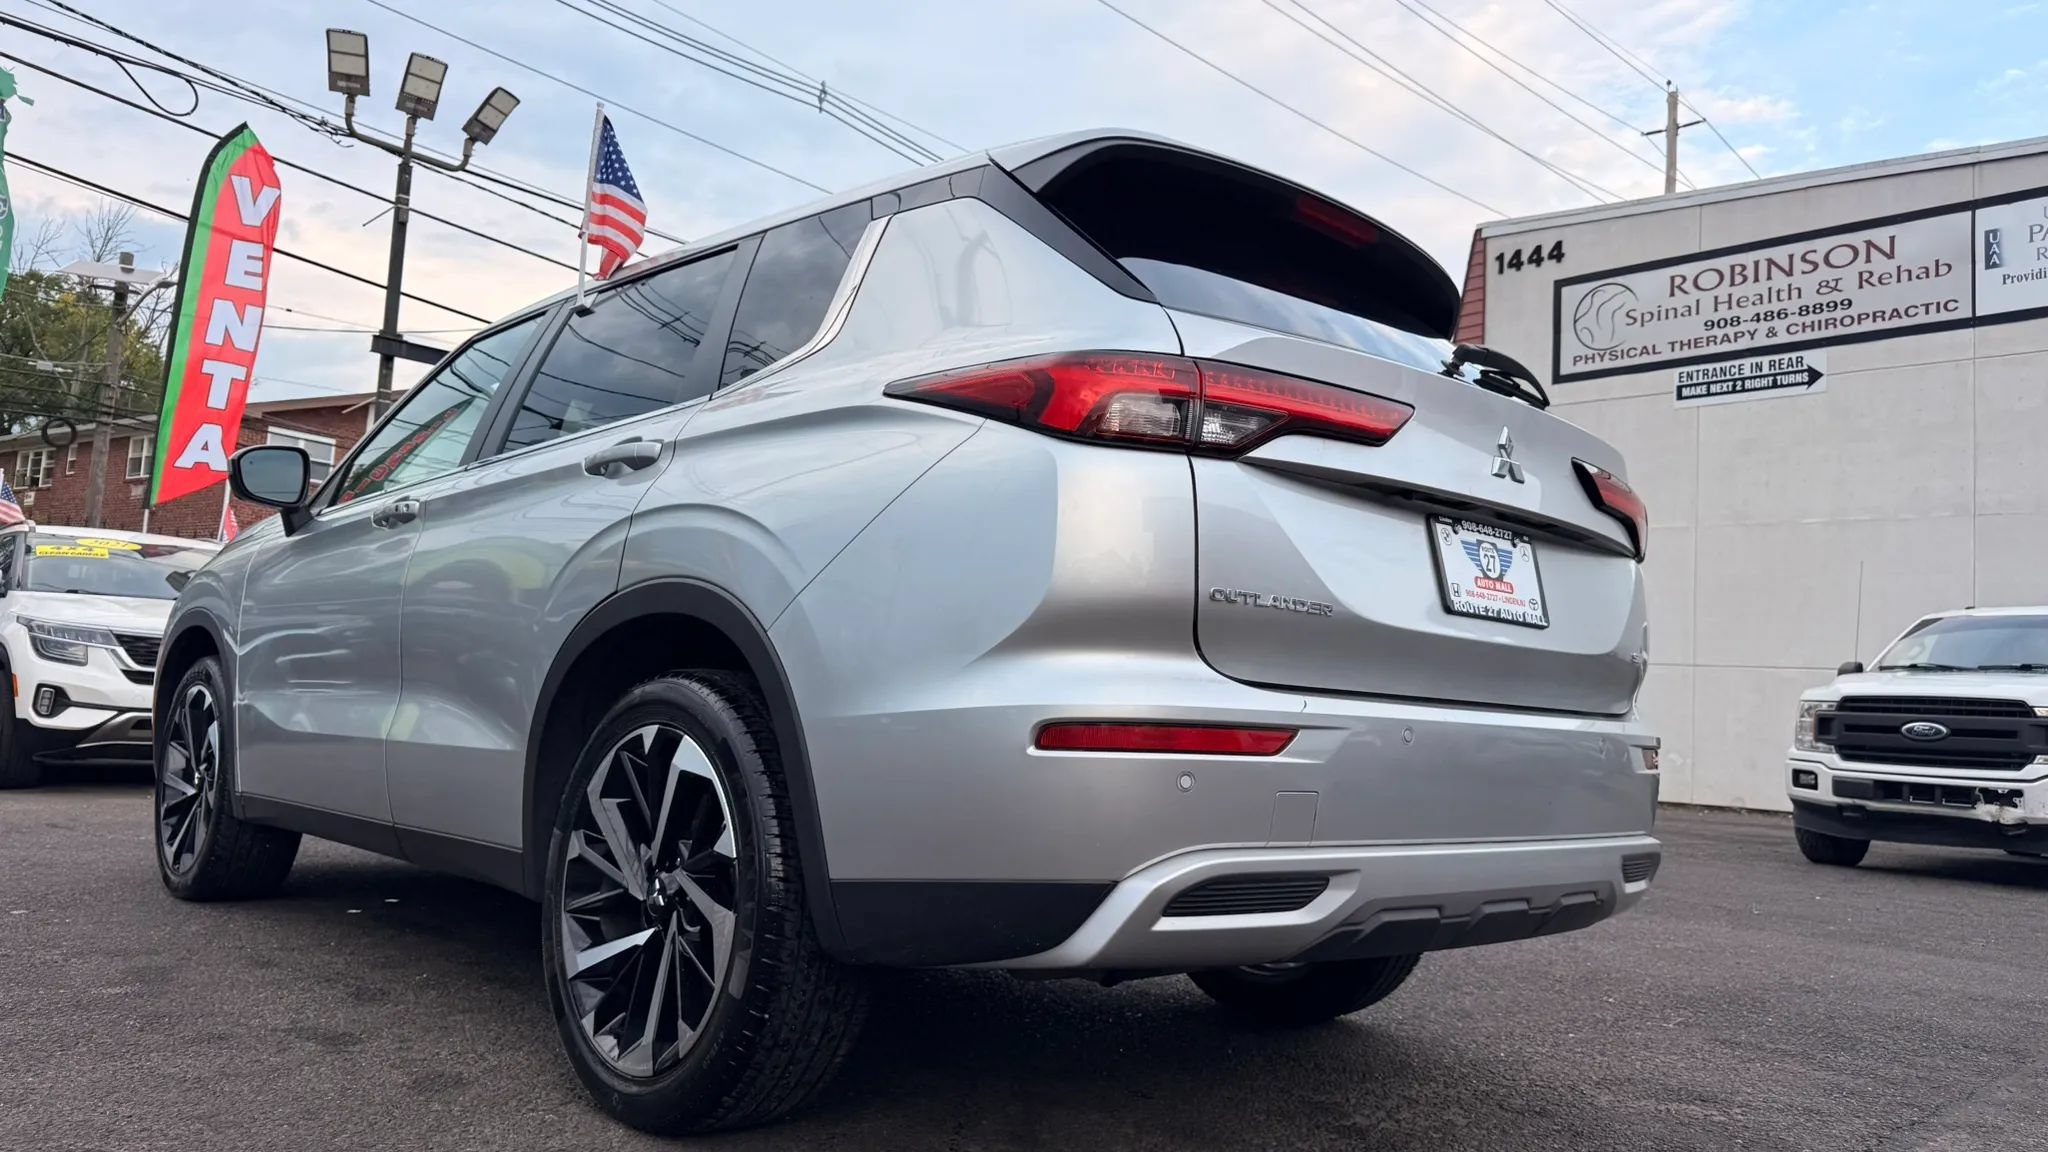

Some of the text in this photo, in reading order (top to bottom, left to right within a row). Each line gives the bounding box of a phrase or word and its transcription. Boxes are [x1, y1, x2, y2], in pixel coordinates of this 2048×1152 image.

[1495, 240, 1565, 275] 1444
[1989, 231, 2000, 266] UAA
[1668, 235, 1896, 298] ROBINSON
[2002, 267, 2047, 285] Providi
[1625, 258, 1953, 327] Spinal Health & Rehab
[173, 175, 281, 472] VENTA
[1704, 298, 1853, 331] 908-486-8899
[1573, 299, 1959, 367] PHYSICAL THERAPY & CHIROPRACTIC
[1678, 356, 1804, 383] ENTRANCE IN REAR
[1681, 372, 1809, 397] MAKE NEXT 2 RIGHT TURNS
[1461, 520, 1512, 540] 908-648-2727
[1483, 553, 1496, 573] 27
[1477, 579, 1513, 592] AUTO MALL
[1210, 587, 1334, 616] OUTLANDER
[1454, 601, 1548, 626] ROUTE 27 AUTO MALL
